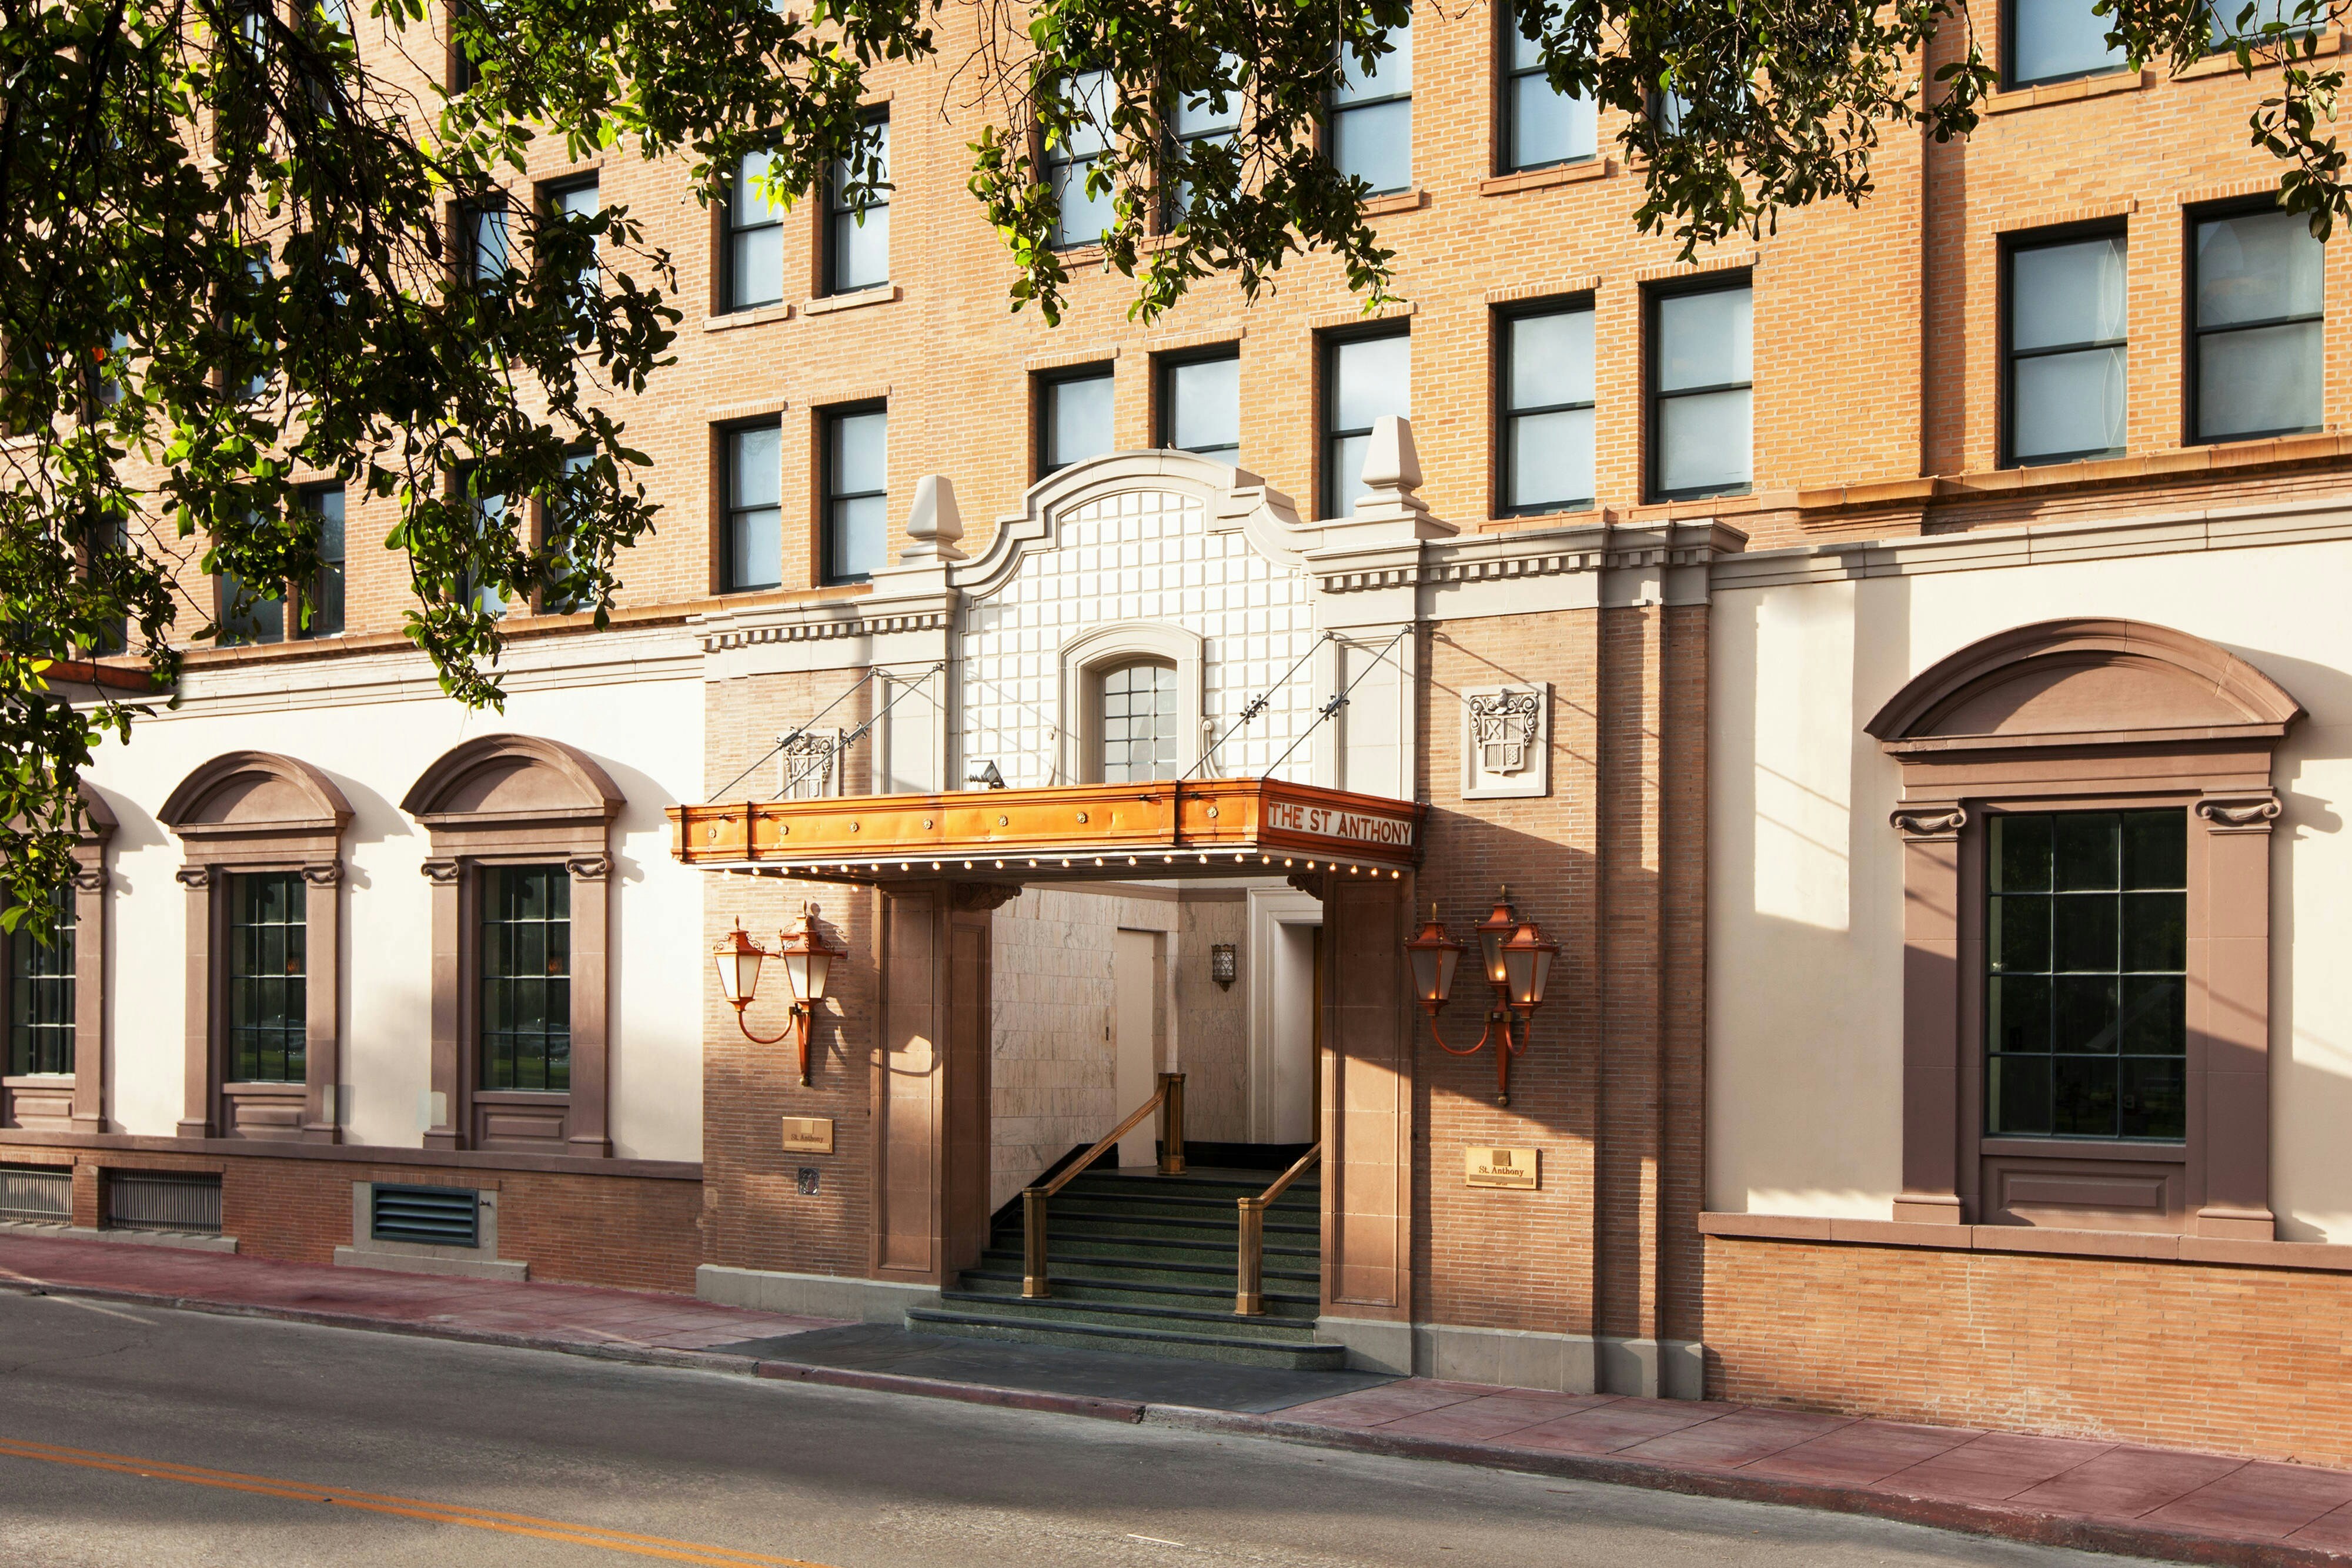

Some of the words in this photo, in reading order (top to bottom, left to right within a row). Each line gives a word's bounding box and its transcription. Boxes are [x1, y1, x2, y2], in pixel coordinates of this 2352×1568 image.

[1269, 802, 1304, 829] THE
[1310, 809, 1331, 832] ST
[1337, 812, 1411, 844] ANTHONY
[800, 1134, 823, 1144] Anthony
[1479, 1165, 1489, 1174] St.
[1491, 1166, 1524, 1177] Anthony
